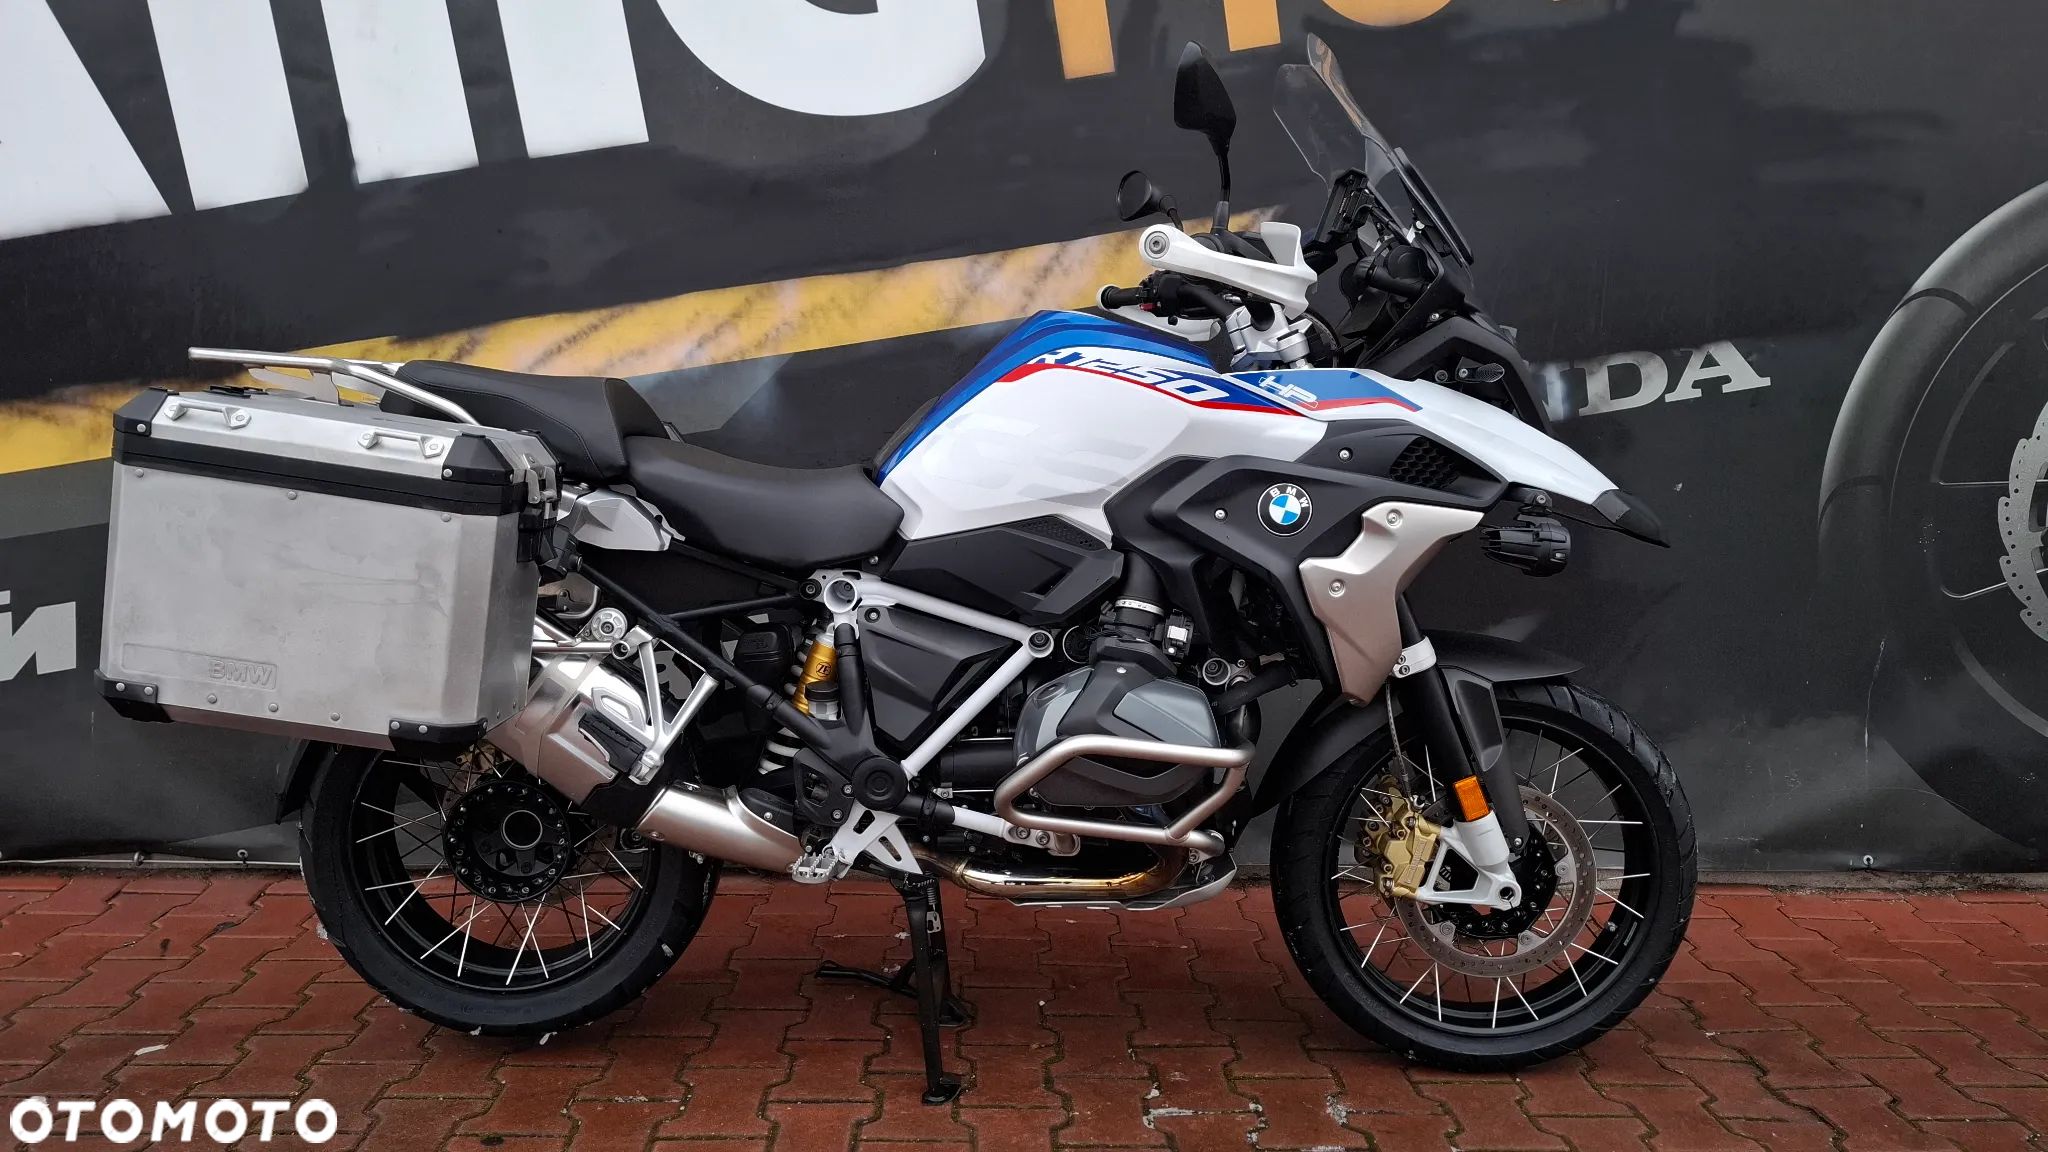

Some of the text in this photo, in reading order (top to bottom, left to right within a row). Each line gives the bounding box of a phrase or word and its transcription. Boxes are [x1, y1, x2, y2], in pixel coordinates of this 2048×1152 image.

[1259, 375, 1318, 407] HP
[1269, 486, 1310, 508] BMW
[208, 660, 274, 686] BMW
